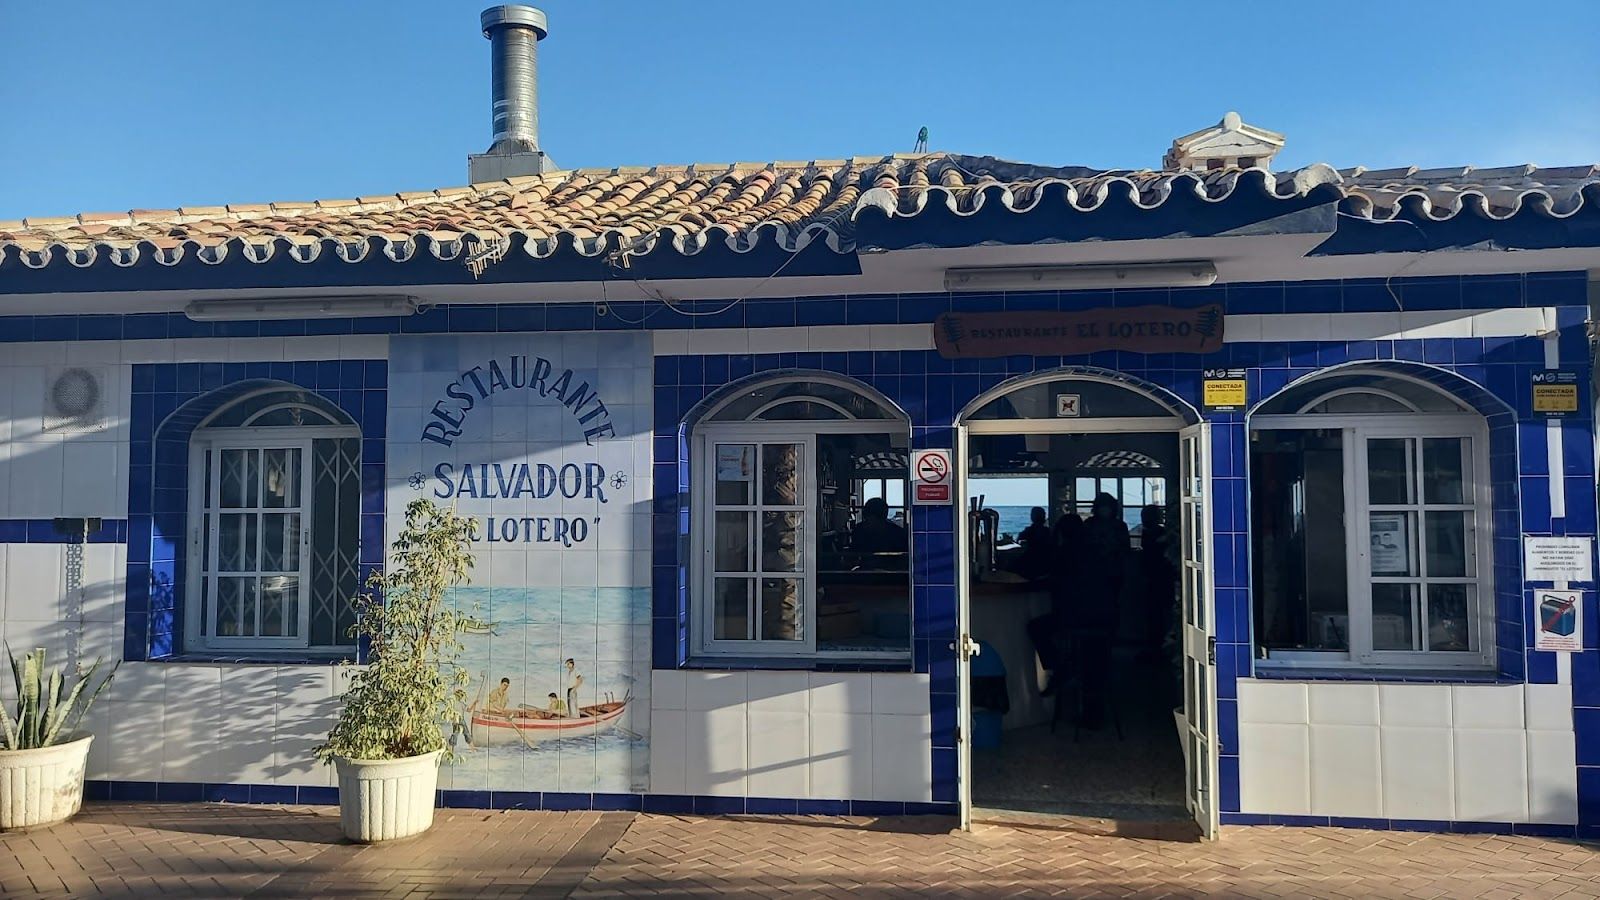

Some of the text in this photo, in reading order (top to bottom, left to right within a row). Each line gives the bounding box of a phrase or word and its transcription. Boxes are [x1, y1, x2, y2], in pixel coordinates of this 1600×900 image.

[1076, 322, 1099, 338] EL
[1108, 321, 1191, 338] LOTERO
[421, 355, 616, 448] RESTAURANTE
[433, 462, 608, 503] SALVADOR
